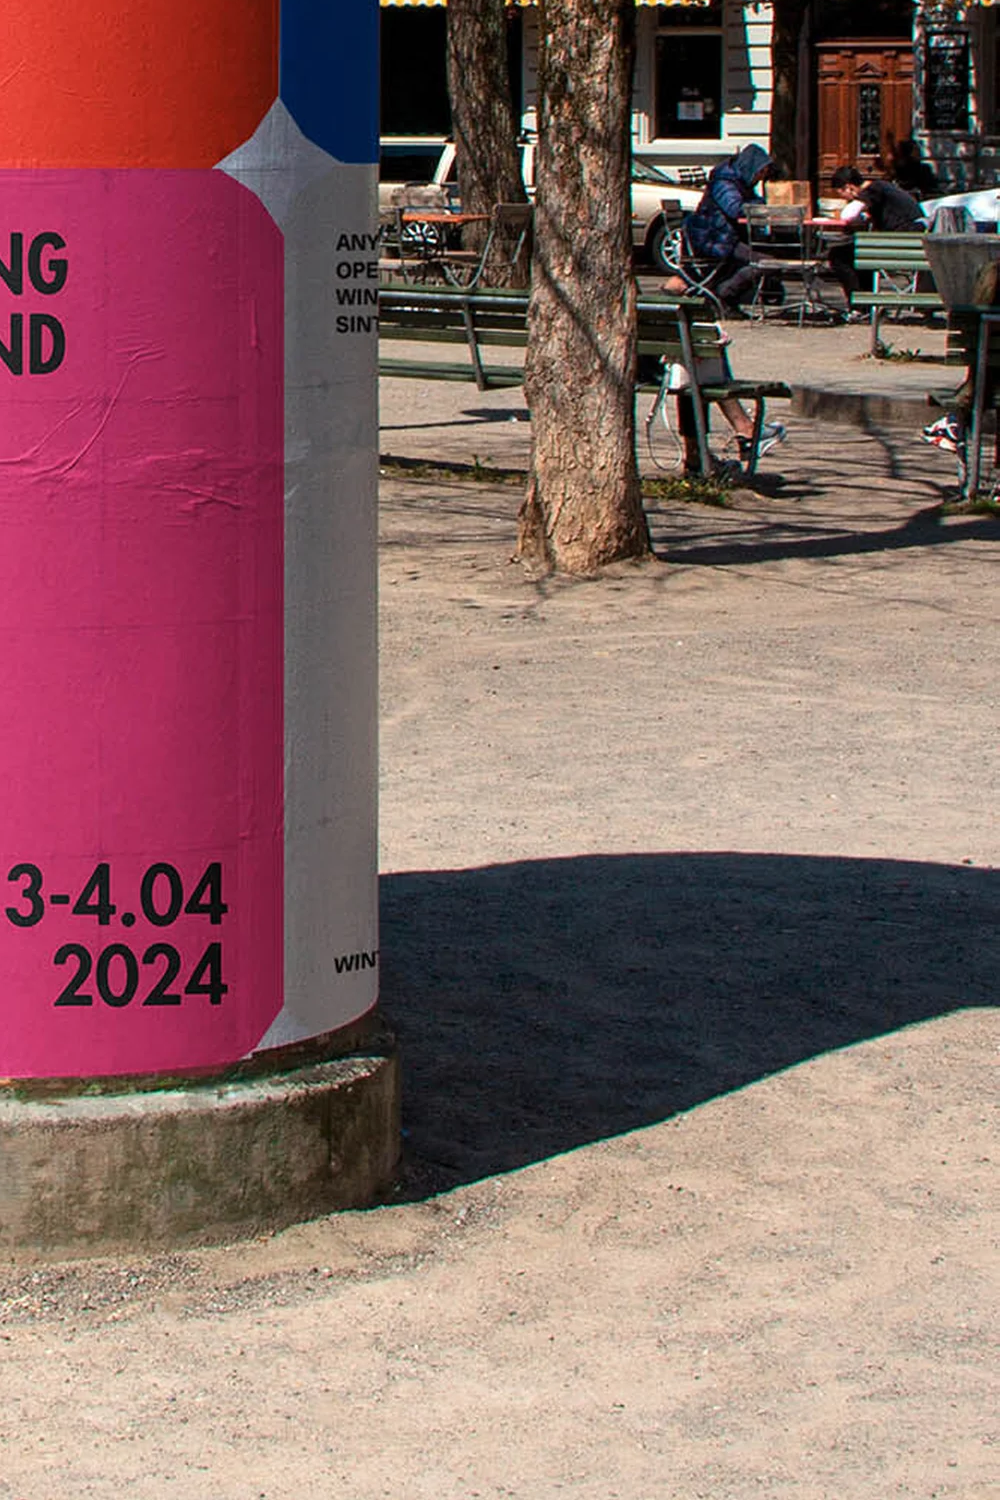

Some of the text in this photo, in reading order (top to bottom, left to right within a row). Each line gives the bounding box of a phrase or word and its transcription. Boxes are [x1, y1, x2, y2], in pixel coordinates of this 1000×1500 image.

[336, 233, 380, 251] ANY
[336, 261, 379, 279] OPE
[5, 862, 229, 928] 3-4.04
[333, 950, 380, 974] WIN
[53, 942, 229, 1008] 2024
